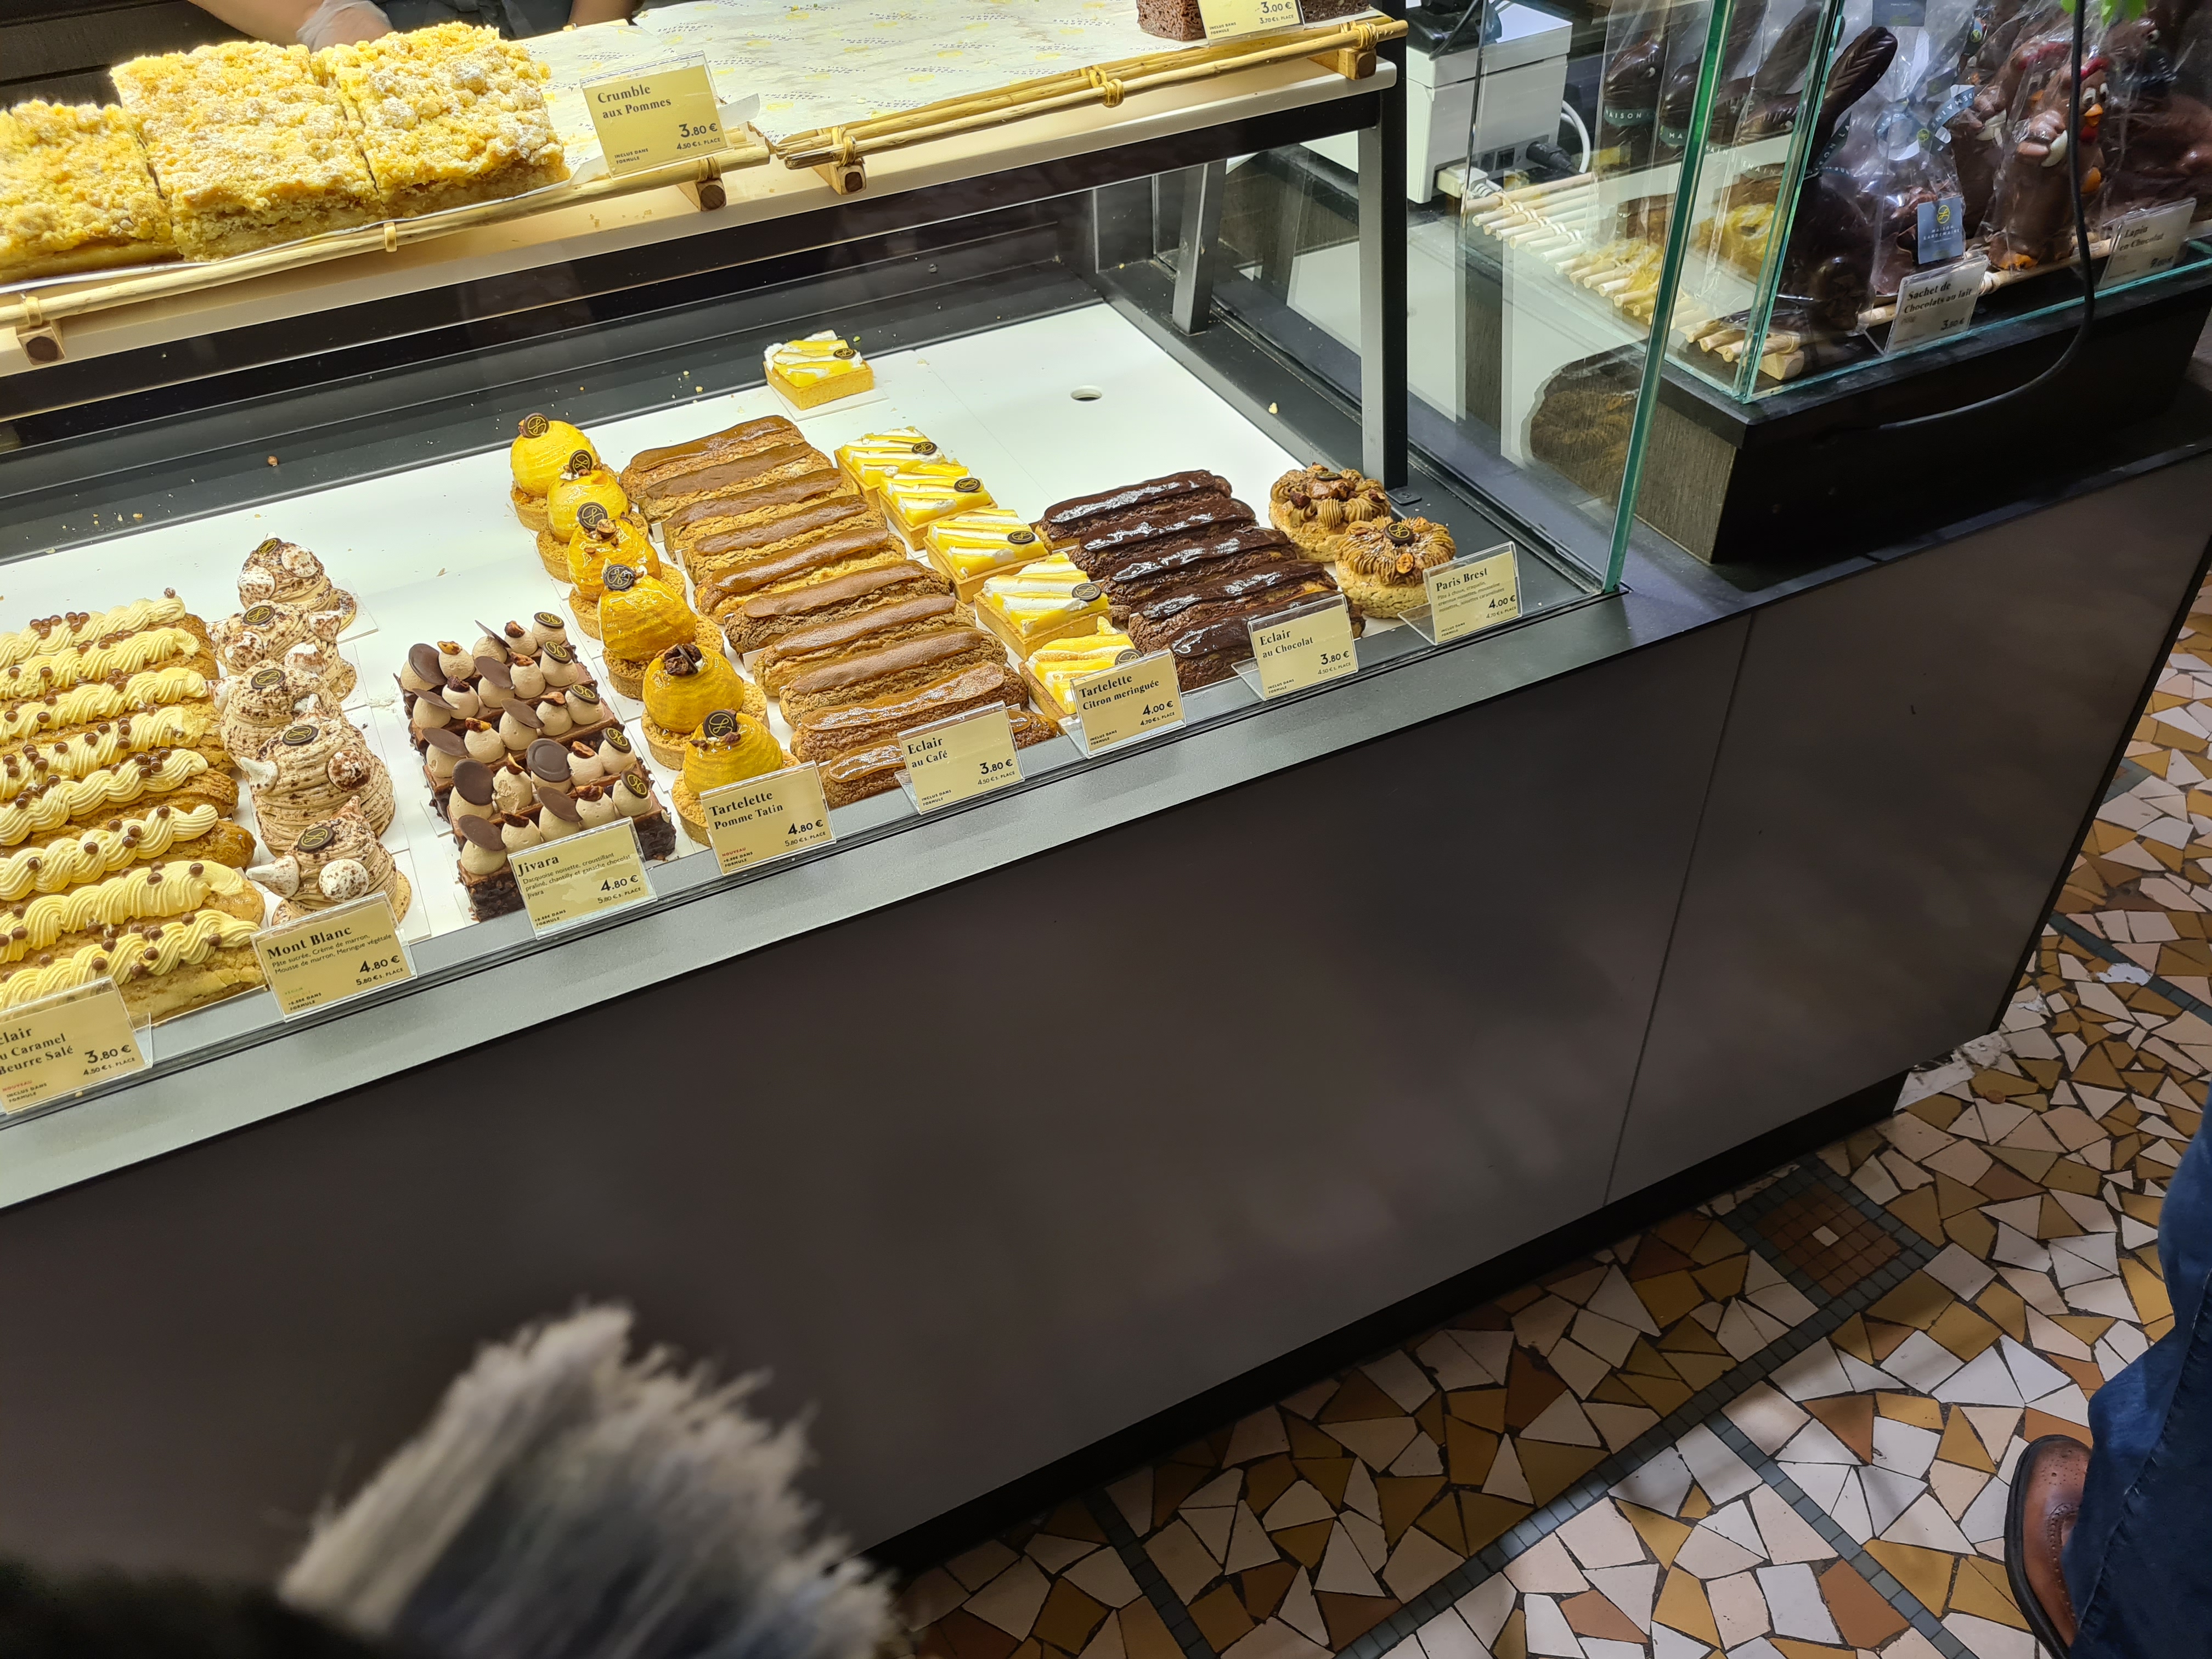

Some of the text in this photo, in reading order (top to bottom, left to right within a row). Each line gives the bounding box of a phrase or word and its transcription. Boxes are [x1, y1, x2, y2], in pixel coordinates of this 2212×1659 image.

[1261, 1, 1283, 14] 3.00
[597, 84, 651, 103] Crumble
[602, 99, 672, 119] aux Pommes
[679, 123, 718, 138] 3.80 €
[616, 156, 640, 165] FORMULE
[2124, 225, 2149, 239] Lapin
[2131, 232, 2165, 248] Chocolat
[1907, 281, 1951, 301] Sachet de
[1904, 297, 1945, 314] Chocolats
[1957, 288, 1973, 299] lait
[1436, 567, 1488, 592] Paris Brest
[1488, 597, 1508, 609] 4.00
[1260, 630, 1291, 646] Eclair
[1262, 637, 1314, 658] au Chocolat
[1321, 653, 1341, 665] 3.80
[1079, 675, 1133, 698] Tartelette
[1083, 680, 1160, 710] Citron meringuée
[1268, 686, 1287, 694] FORMULE
[1142, 703, 1165, 715] 4.00
[907, 737, 943, 755] Eclair
[1091, 737, 1110, 746] FORMULE
[911, 750, 948, 768] au Café
[979, 762, 1003, 775] 3.80
[709, 792, 773, 817] Tartelette
[921, 793, 939, 802] INCLUS
[923, 797, 944, 806] FORMULE
[714, 804, 784, 830] Pomme Tatin
[787, 819, 823, 835] 4.80 €
[785, 839, 798, 847] 5.80
[809, 831, 826, 839] PLACE
[722, 847, 746, 857] NOUVEAU
[518, 856, 560, 877] Jivara
[522, 853, 615, 884] Dacquoise noisette, croustillant
[725, 858, 747, 867] FORMULE
[525, 881, 548, 892] praliné,
[549, 873, 573, 884] chantilly
[582, 863, 606, 874] ganache
[607, 854, 631, 866] chocolat
[601, 874, 639, 891] 4.80 €
[624, 887, 641, 895] PLACE
[527, 890, 545, 900] Jivara
[536, 916, 560, 927] FORMULE
[267, 927, 353, 960] Mont Blanc
[272, 960, 286, 968] Pâte
[288, 952, 311, 963] sucrée,
[312, 945, 334, 956] Crème
[345, 935, 370, 945] marron,
[275, 963, 299, 975] Mousse
[311, 952, 336, 964] marron,
[336, 943, 366, 955] Meringue
[367, 933, 392, 946] végétale
[359, 955, 400, 973] 4.80 €
[356, 976, 373, 986] 5.80
[386, 967, 404, 977] PLACE
[290, 1000, 315, 1011] FORMULE
[11, 1032, 66, 1057] Caramel
[0, 1045, 74, 1076] Beurre Salé
[84, 1044, 132, 1064] 3.80 €
[83, 1067, 101, 1076] 4.50
[115, 1057, 136, 1067] PLACE
[7, 1082, 47, 1098] INCLUS DANS
[9, 1091, 37, 1103] FORMULE
